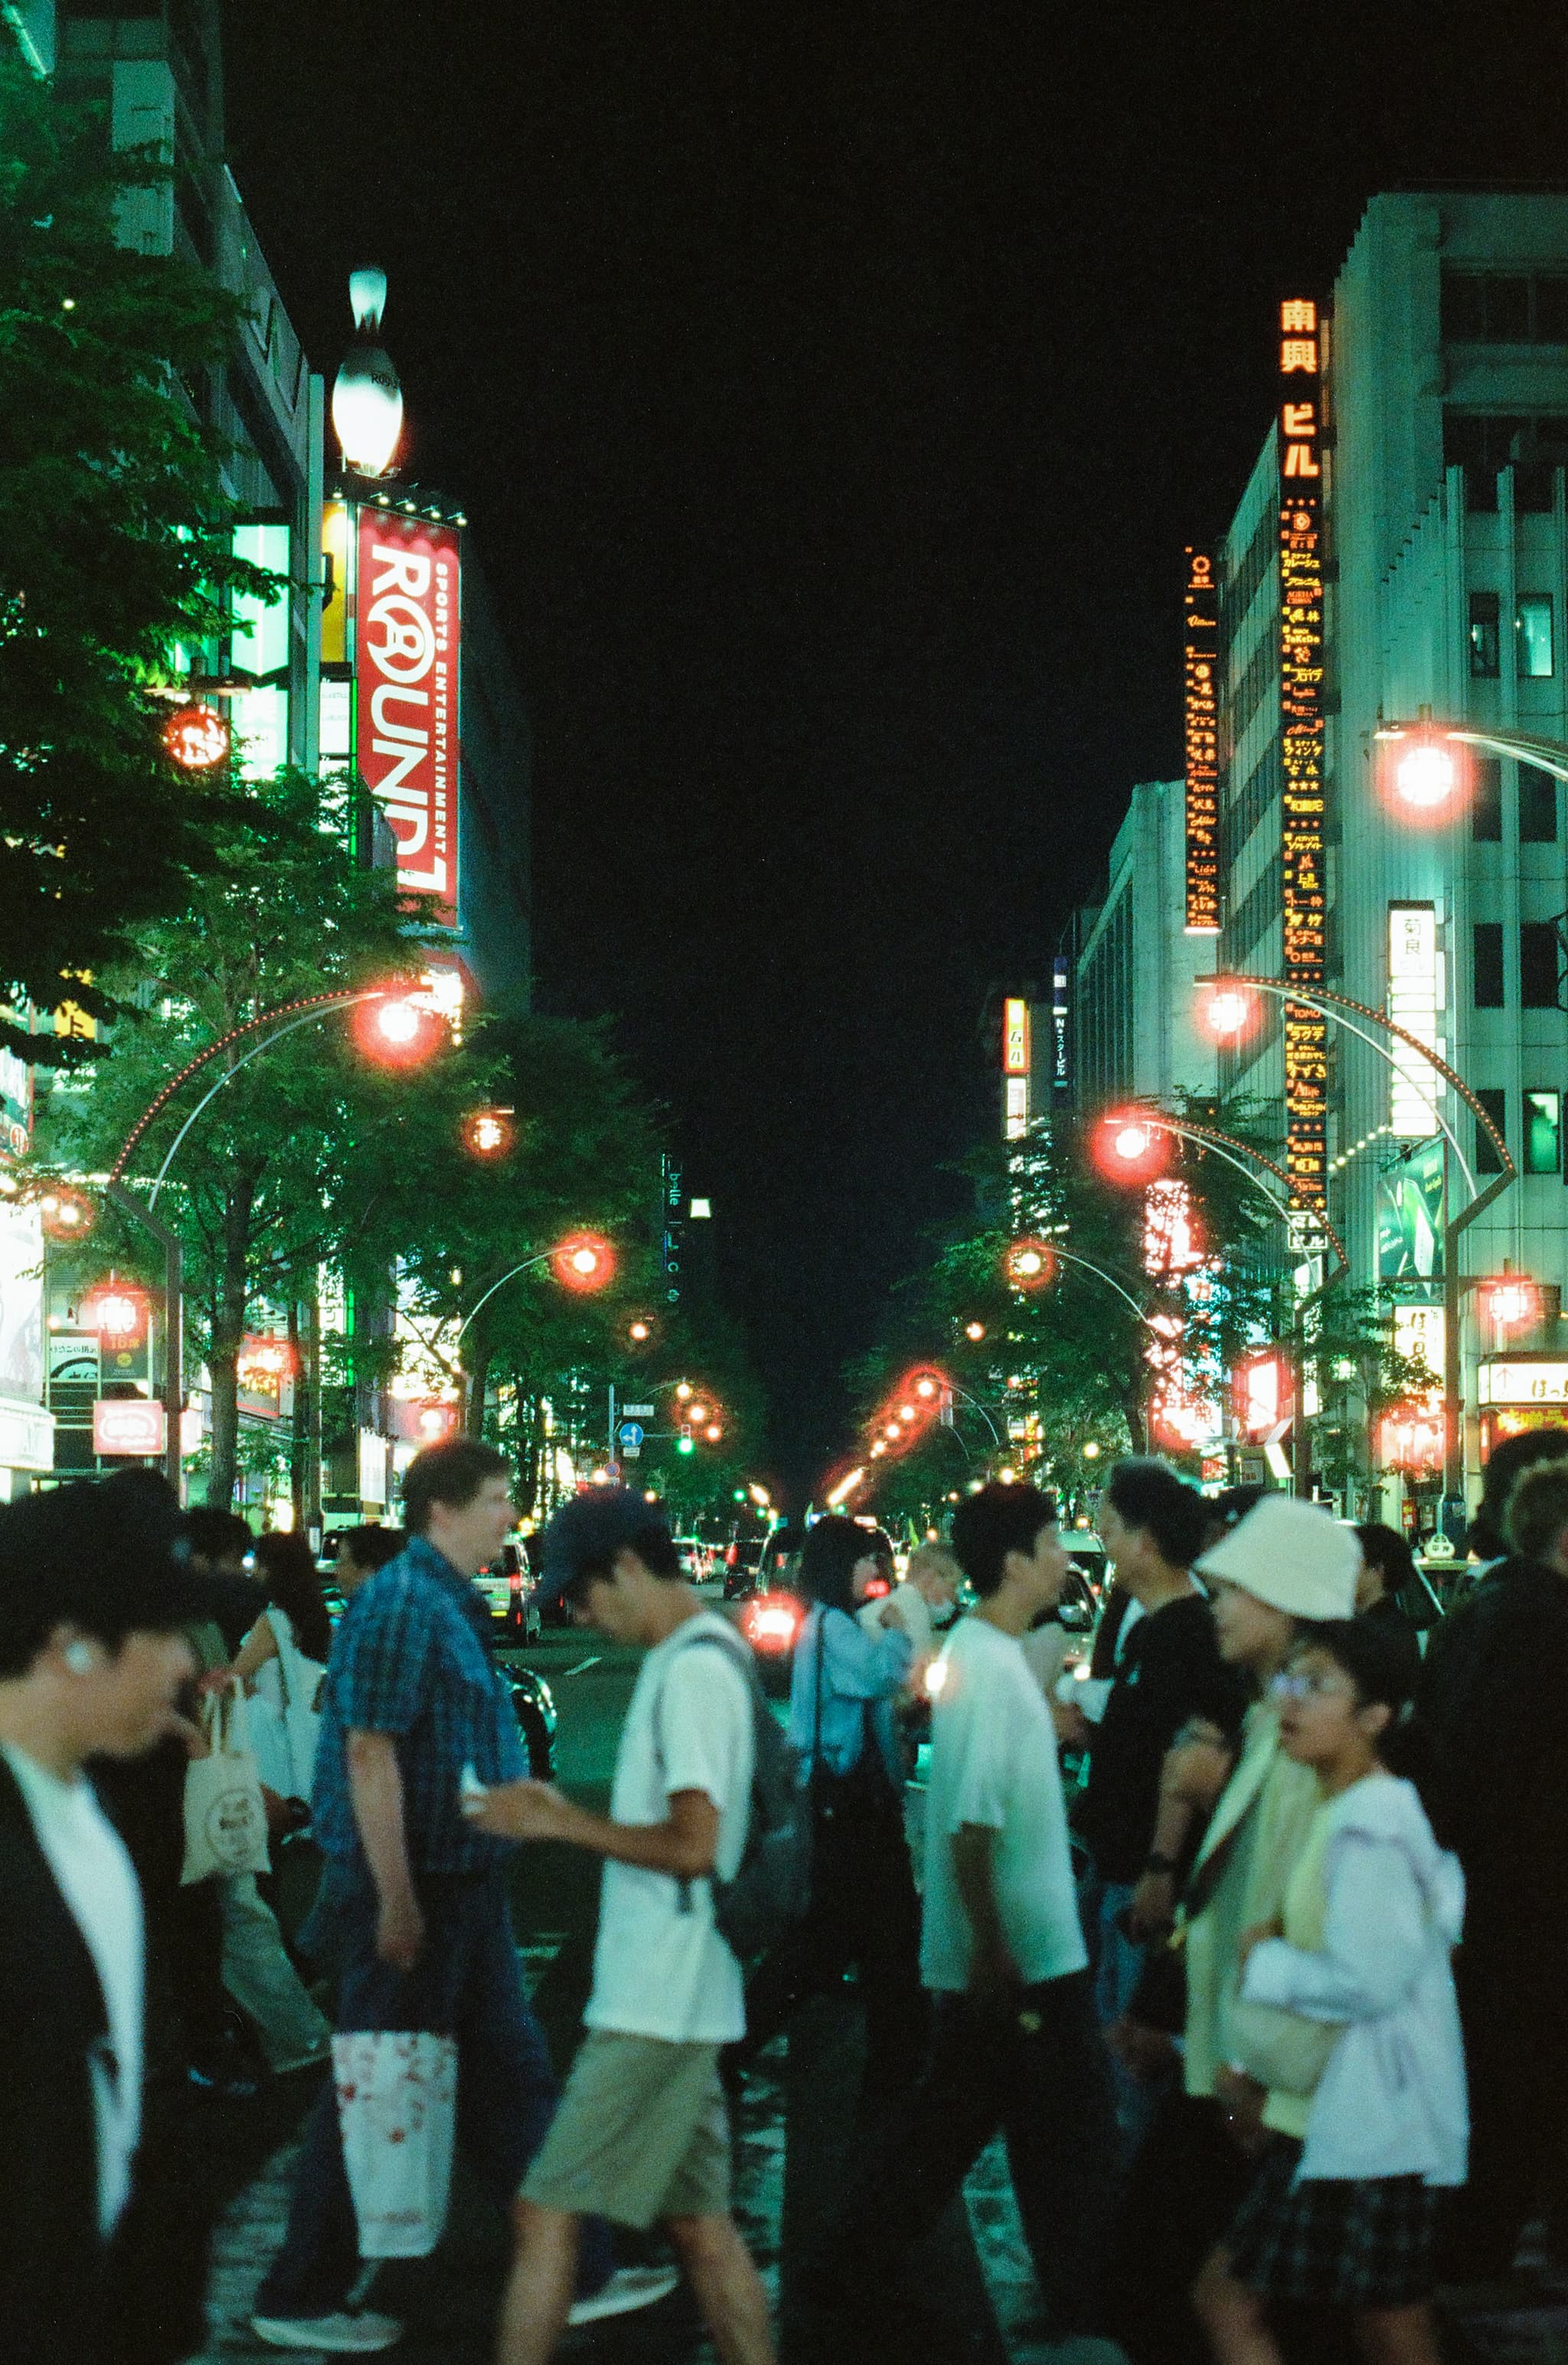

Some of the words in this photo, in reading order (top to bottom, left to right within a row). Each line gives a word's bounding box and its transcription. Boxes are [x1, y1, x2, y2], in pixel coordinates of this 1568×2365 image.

[434, 563, 450, 651] SPORTS
[432, 661, 449, 854] ENTERTAINMENT
[1403, 919, 1422, 955] 菊良
[1294, 1010, 1321, 1018] TOMO
